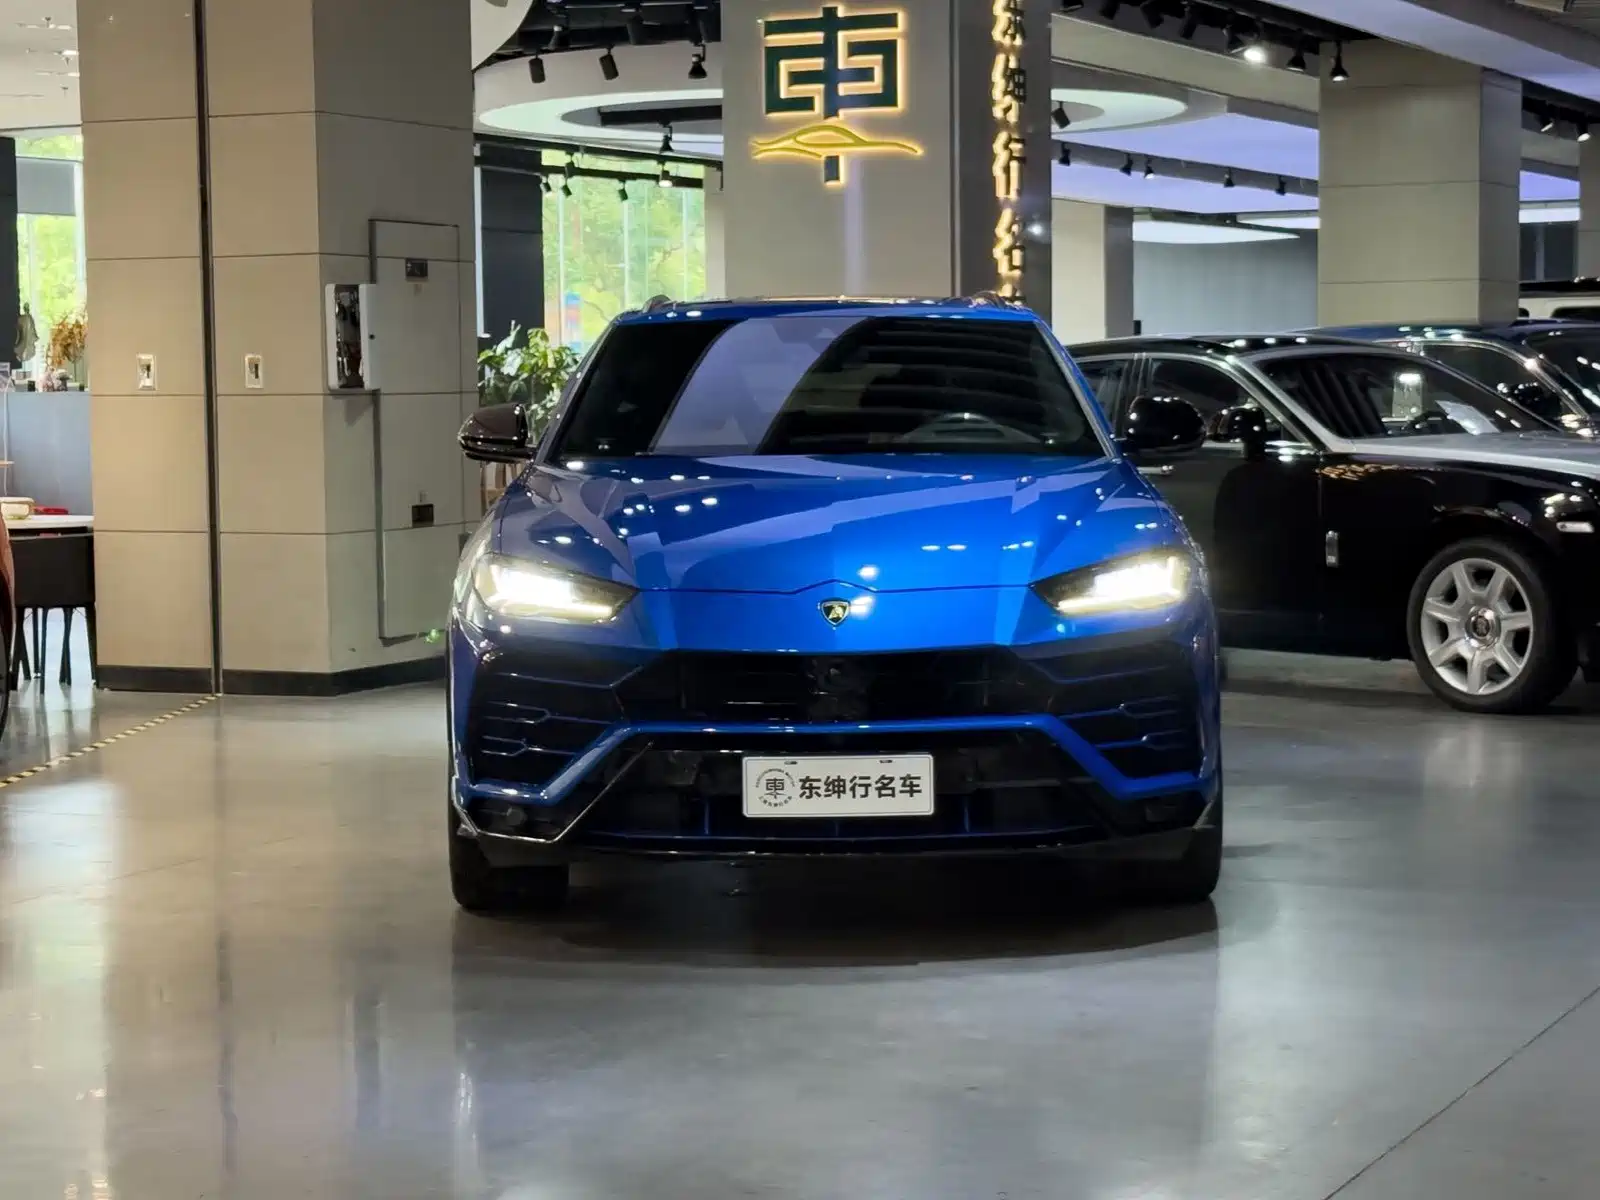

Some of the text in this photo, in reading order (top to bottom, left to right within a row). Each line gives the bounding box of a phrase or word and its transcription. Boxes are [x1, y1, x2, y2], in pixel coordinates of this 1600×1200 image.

[991, 0, 1025, 303] 东绅行名
[799, 774, 922, 799] 东绅行名车
